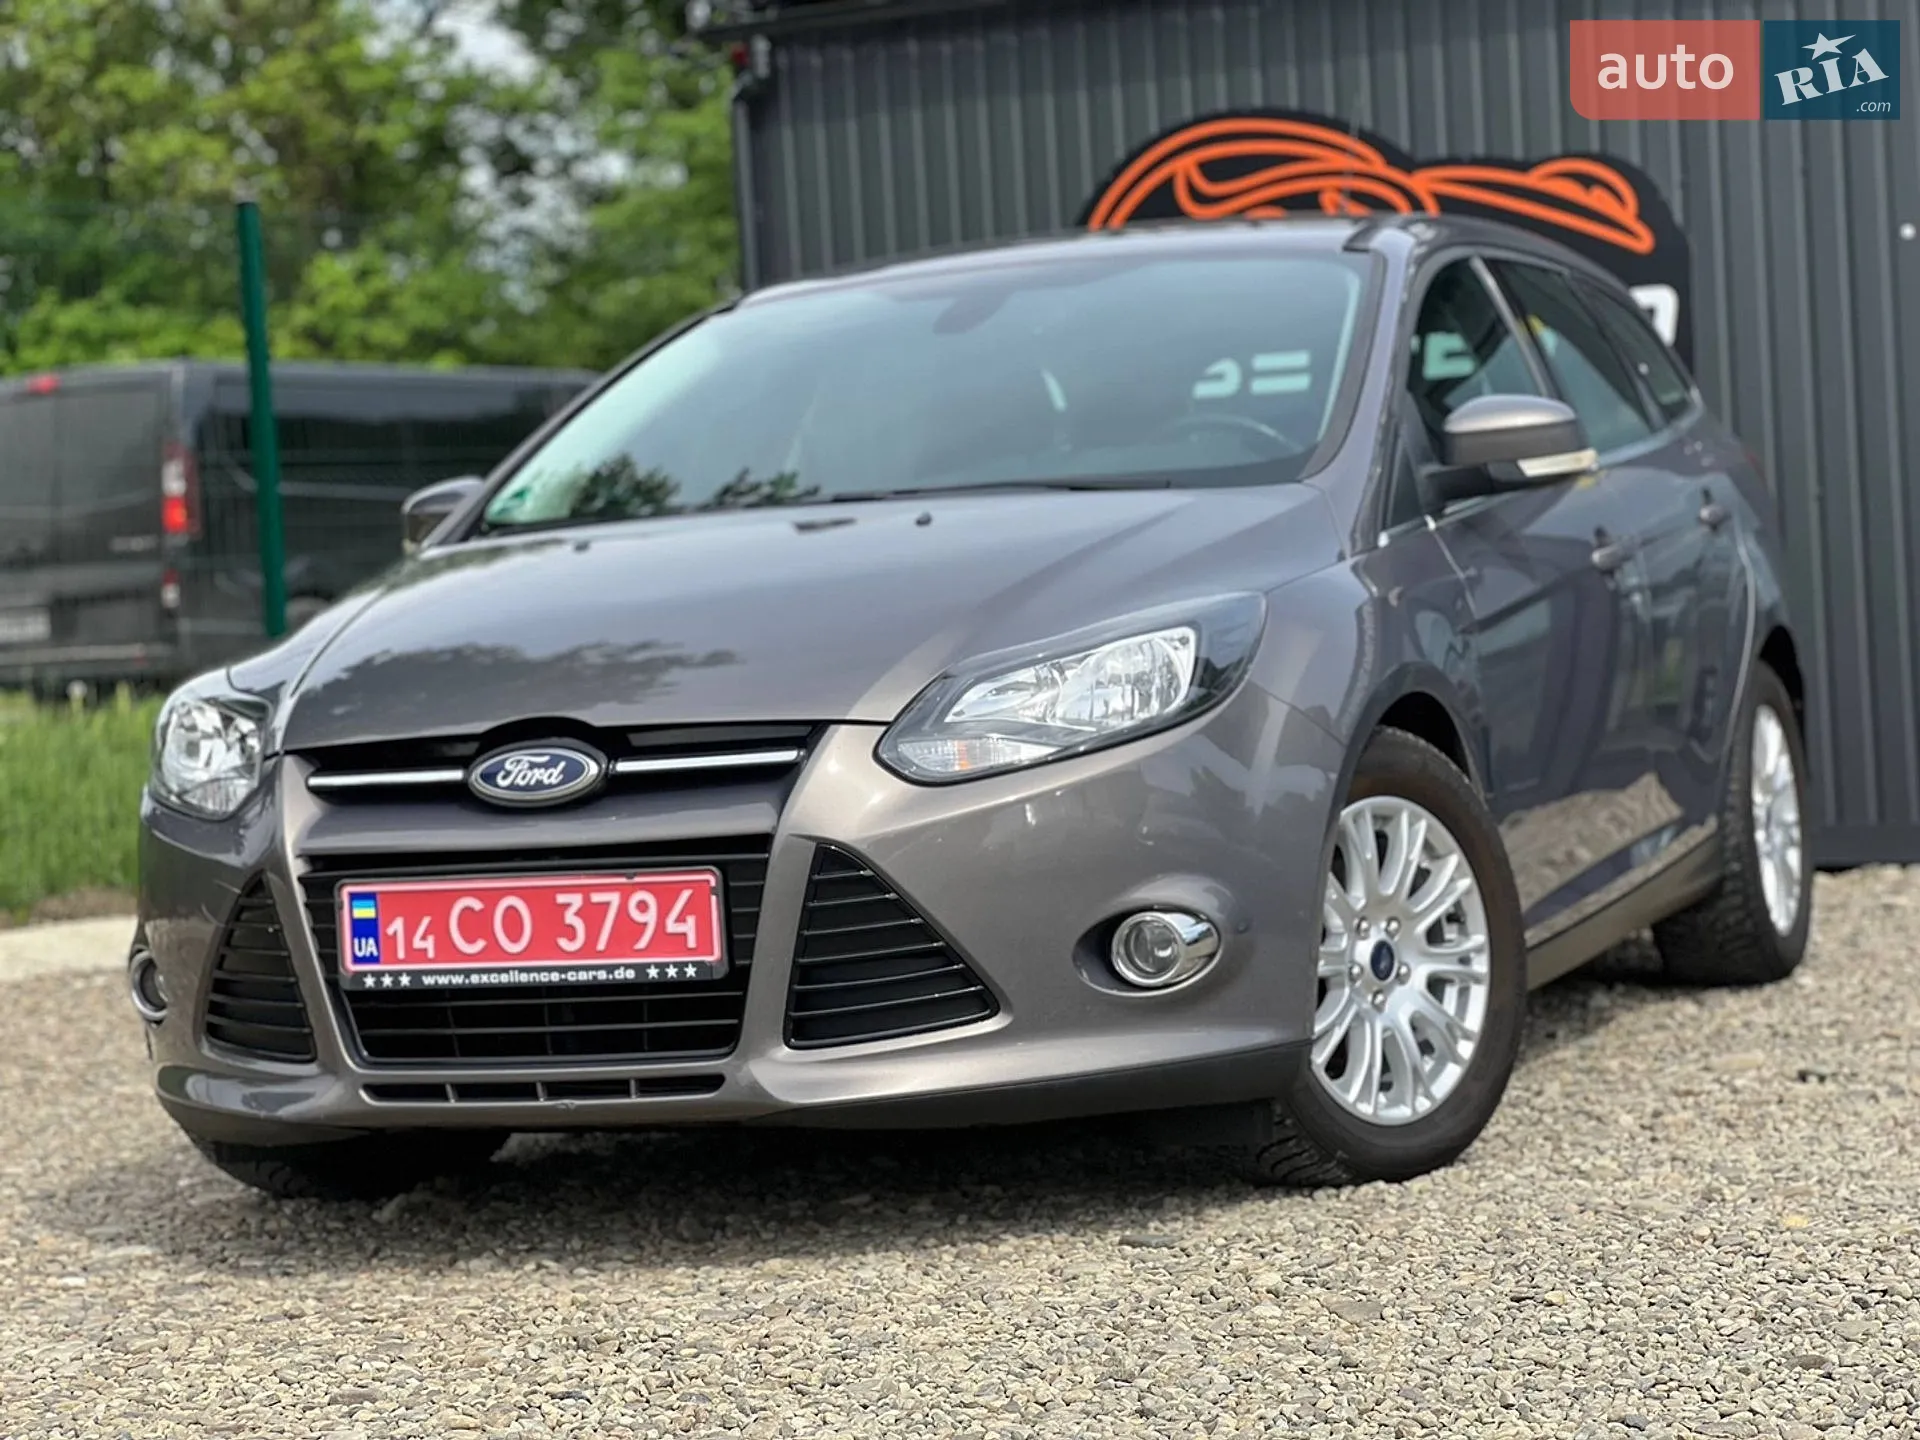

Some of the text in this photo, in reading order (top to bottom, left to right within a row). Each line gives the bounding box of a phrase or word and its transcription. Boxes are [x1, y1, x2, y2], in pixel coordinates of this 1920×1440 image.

[495, 755, 566, 788] Ford
[385, 889, 698, 960] 14 CO 3794
[353, 936, 378, 957] UA
[421, 966, 635, 985] www.excellence-cars.de
